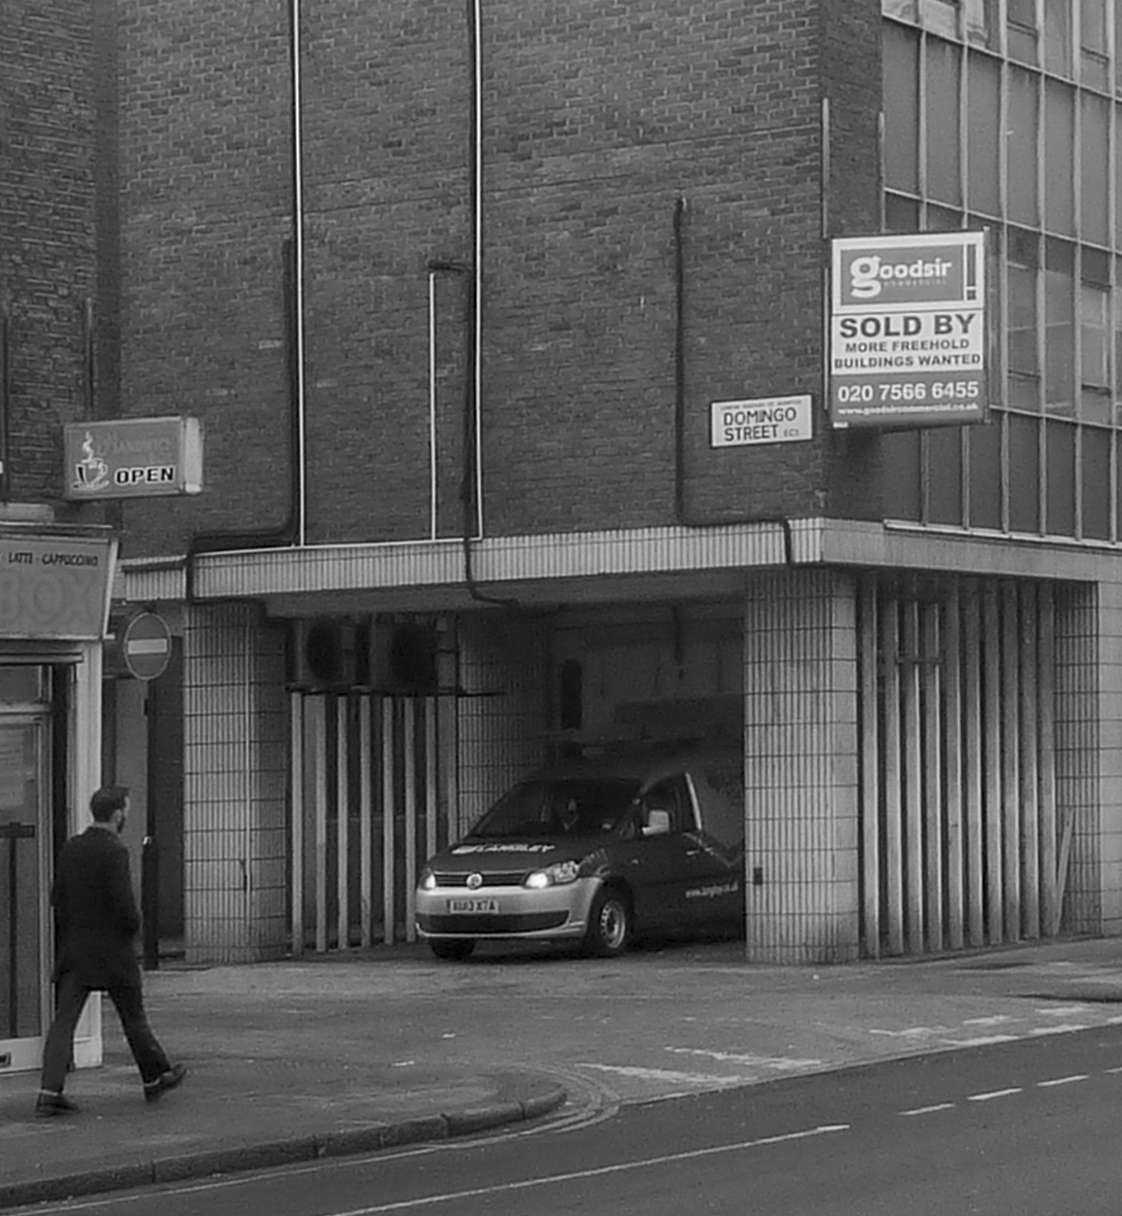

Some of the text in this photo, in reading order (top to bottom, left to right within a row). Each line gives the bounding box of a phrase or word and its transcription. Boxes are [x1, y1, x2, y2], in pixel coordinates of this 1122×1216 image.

[849, 255, 953, 299] goodsir
[839, 313, 977, 339] SOLD BY
[845, 338, 970, 354] MORE FREEHOLD
[834, 353, 982, 370] BUILDINGS WANTED
[837, 381, 980, 403] 020 7566 6455
[723, 406, 797, 426] DOMINGO
[724, 424, 779, 442] STREET
[115, 466, 175, 485] OPEN
